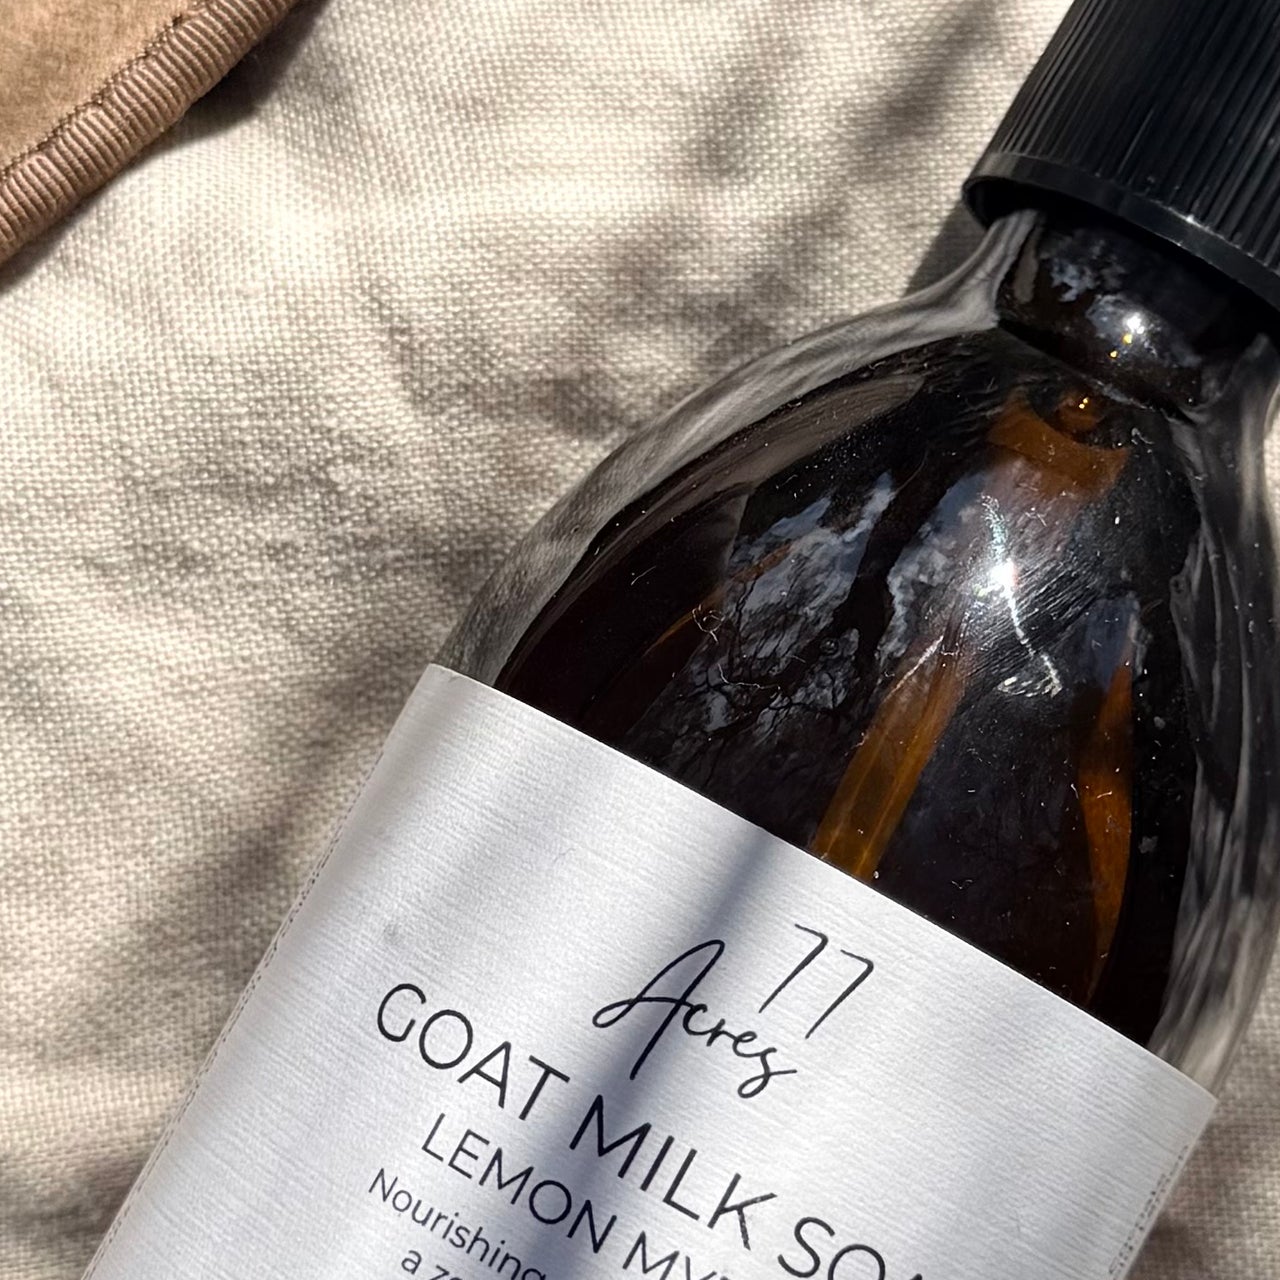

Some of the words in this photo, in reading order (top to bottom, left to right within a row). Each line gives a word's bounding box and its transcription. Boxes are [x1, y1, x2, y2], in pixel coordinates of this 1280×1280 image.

[591, 938, 798, 1100] Acres
[758, 923, 875, 1040] 77
[376, 982, 571, 1121] GOAT
[568, 1093, 778, 1251] MILK
[421, 1112, 618, 1255] LEMON
[400, 1249, 423, 1276] a
